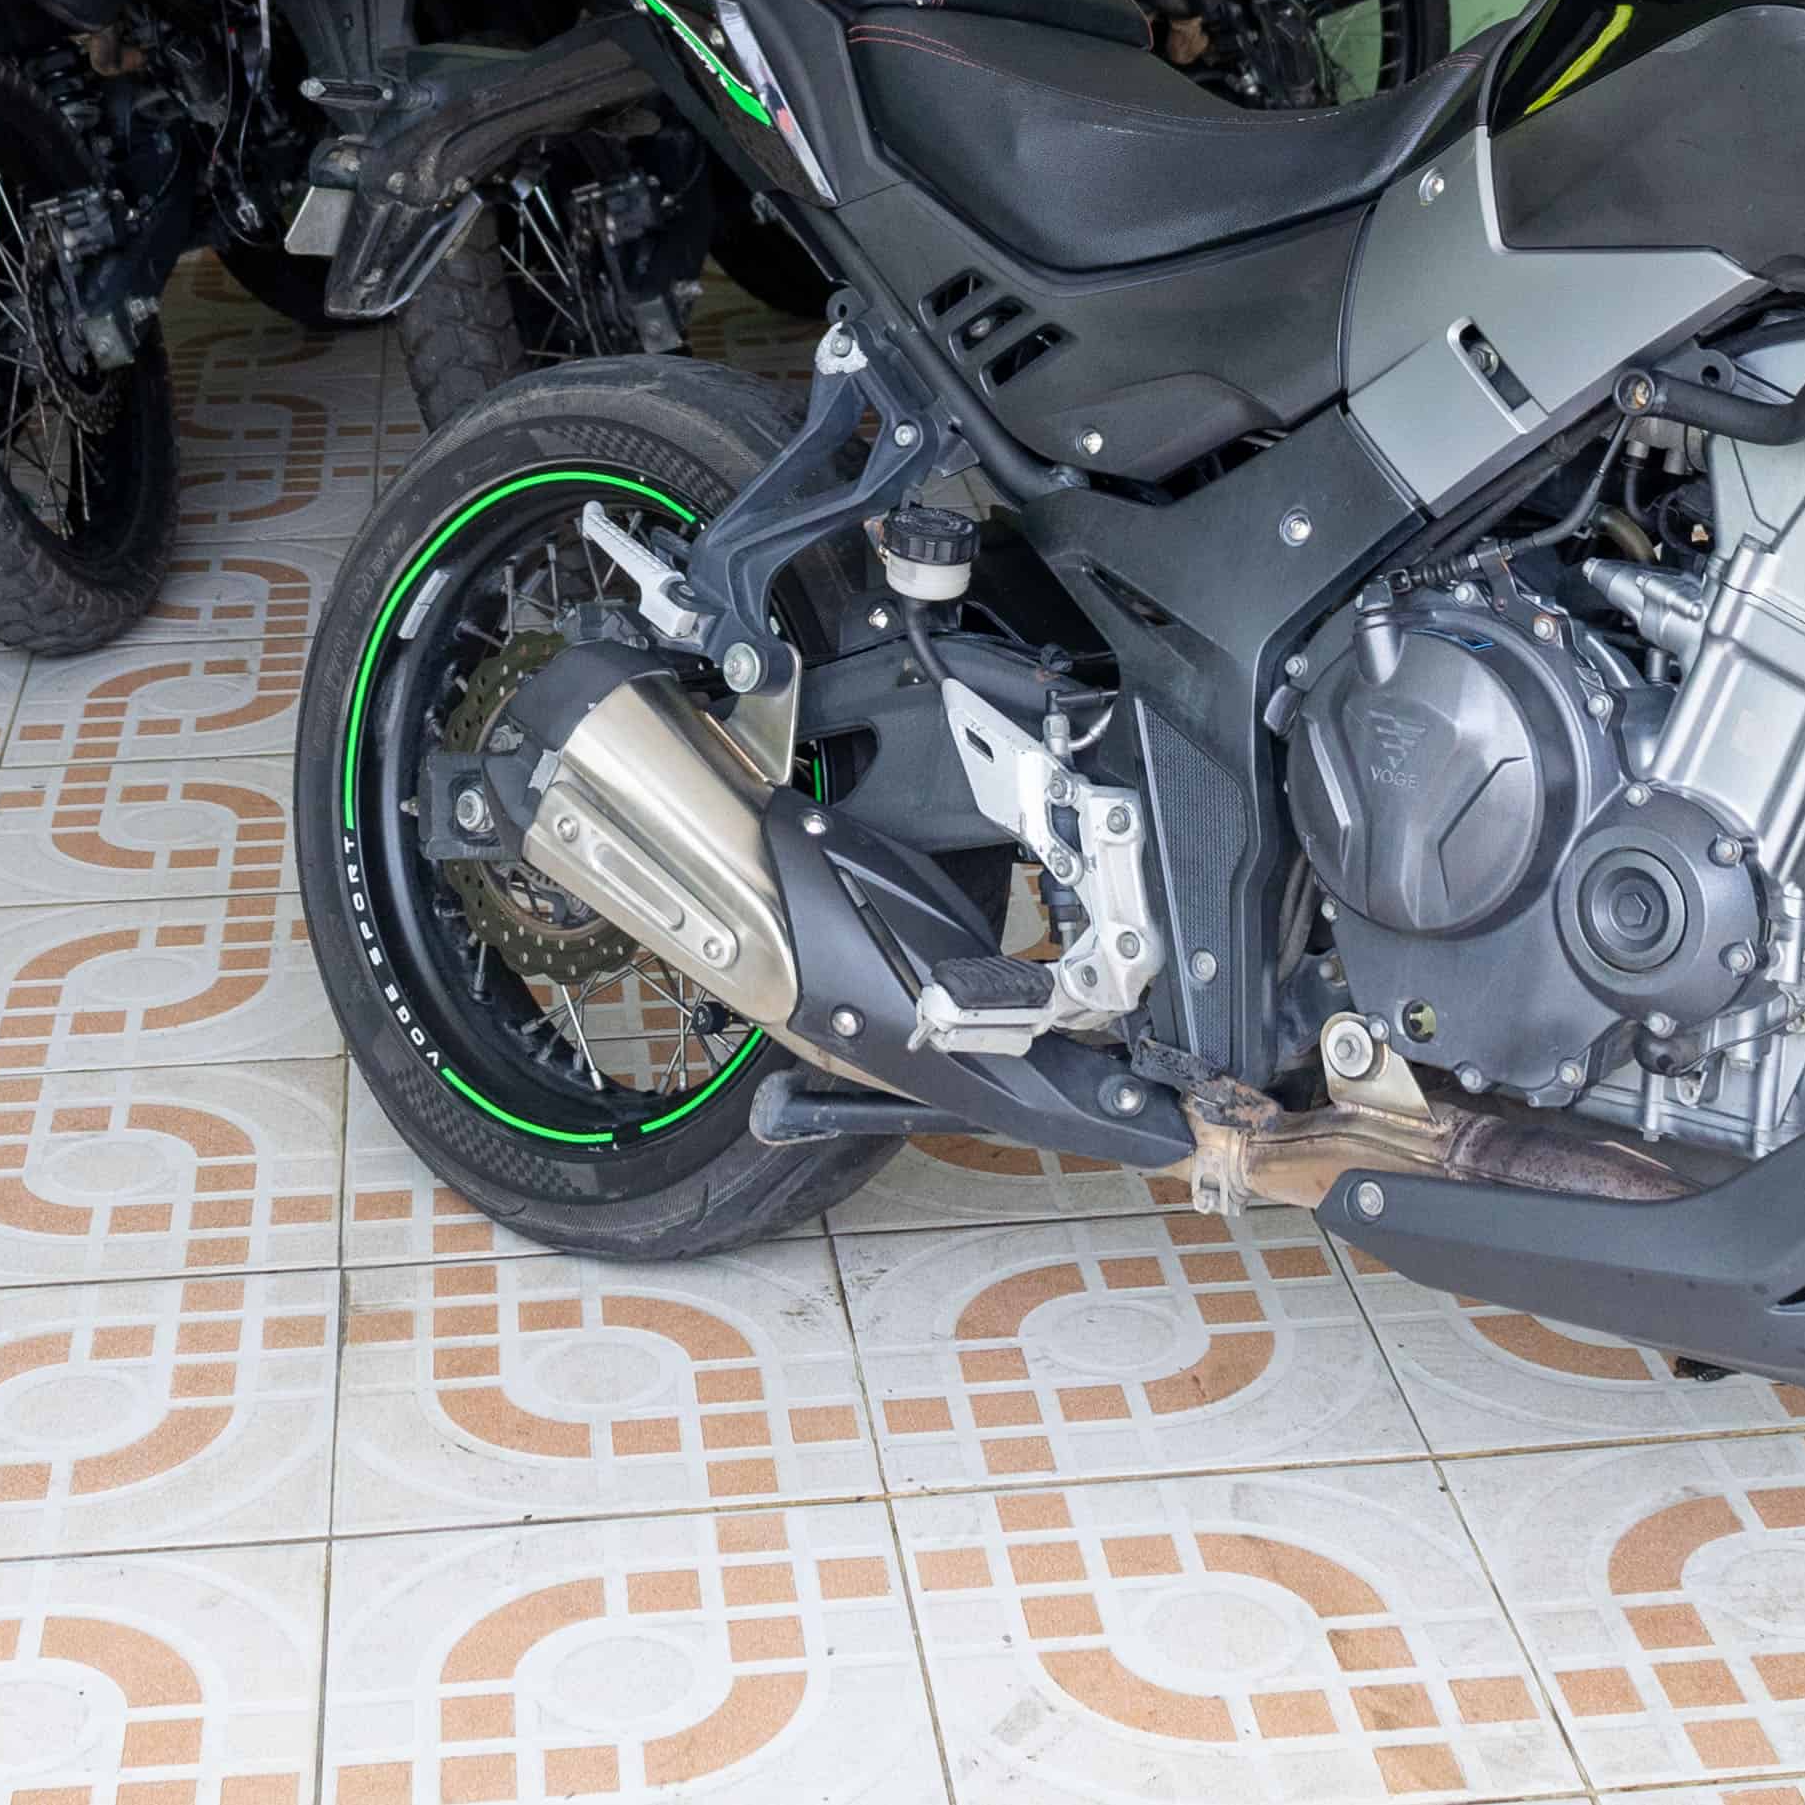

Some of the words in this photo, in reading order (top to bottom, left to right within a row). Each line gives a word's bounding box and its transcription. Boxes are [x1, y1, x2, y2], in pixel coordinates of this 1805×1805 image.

[1370, 764, 1418, 789] VOGE
[343, 836, 383, 967] SPORT
[384, 982, 440, 1066] VOGE
